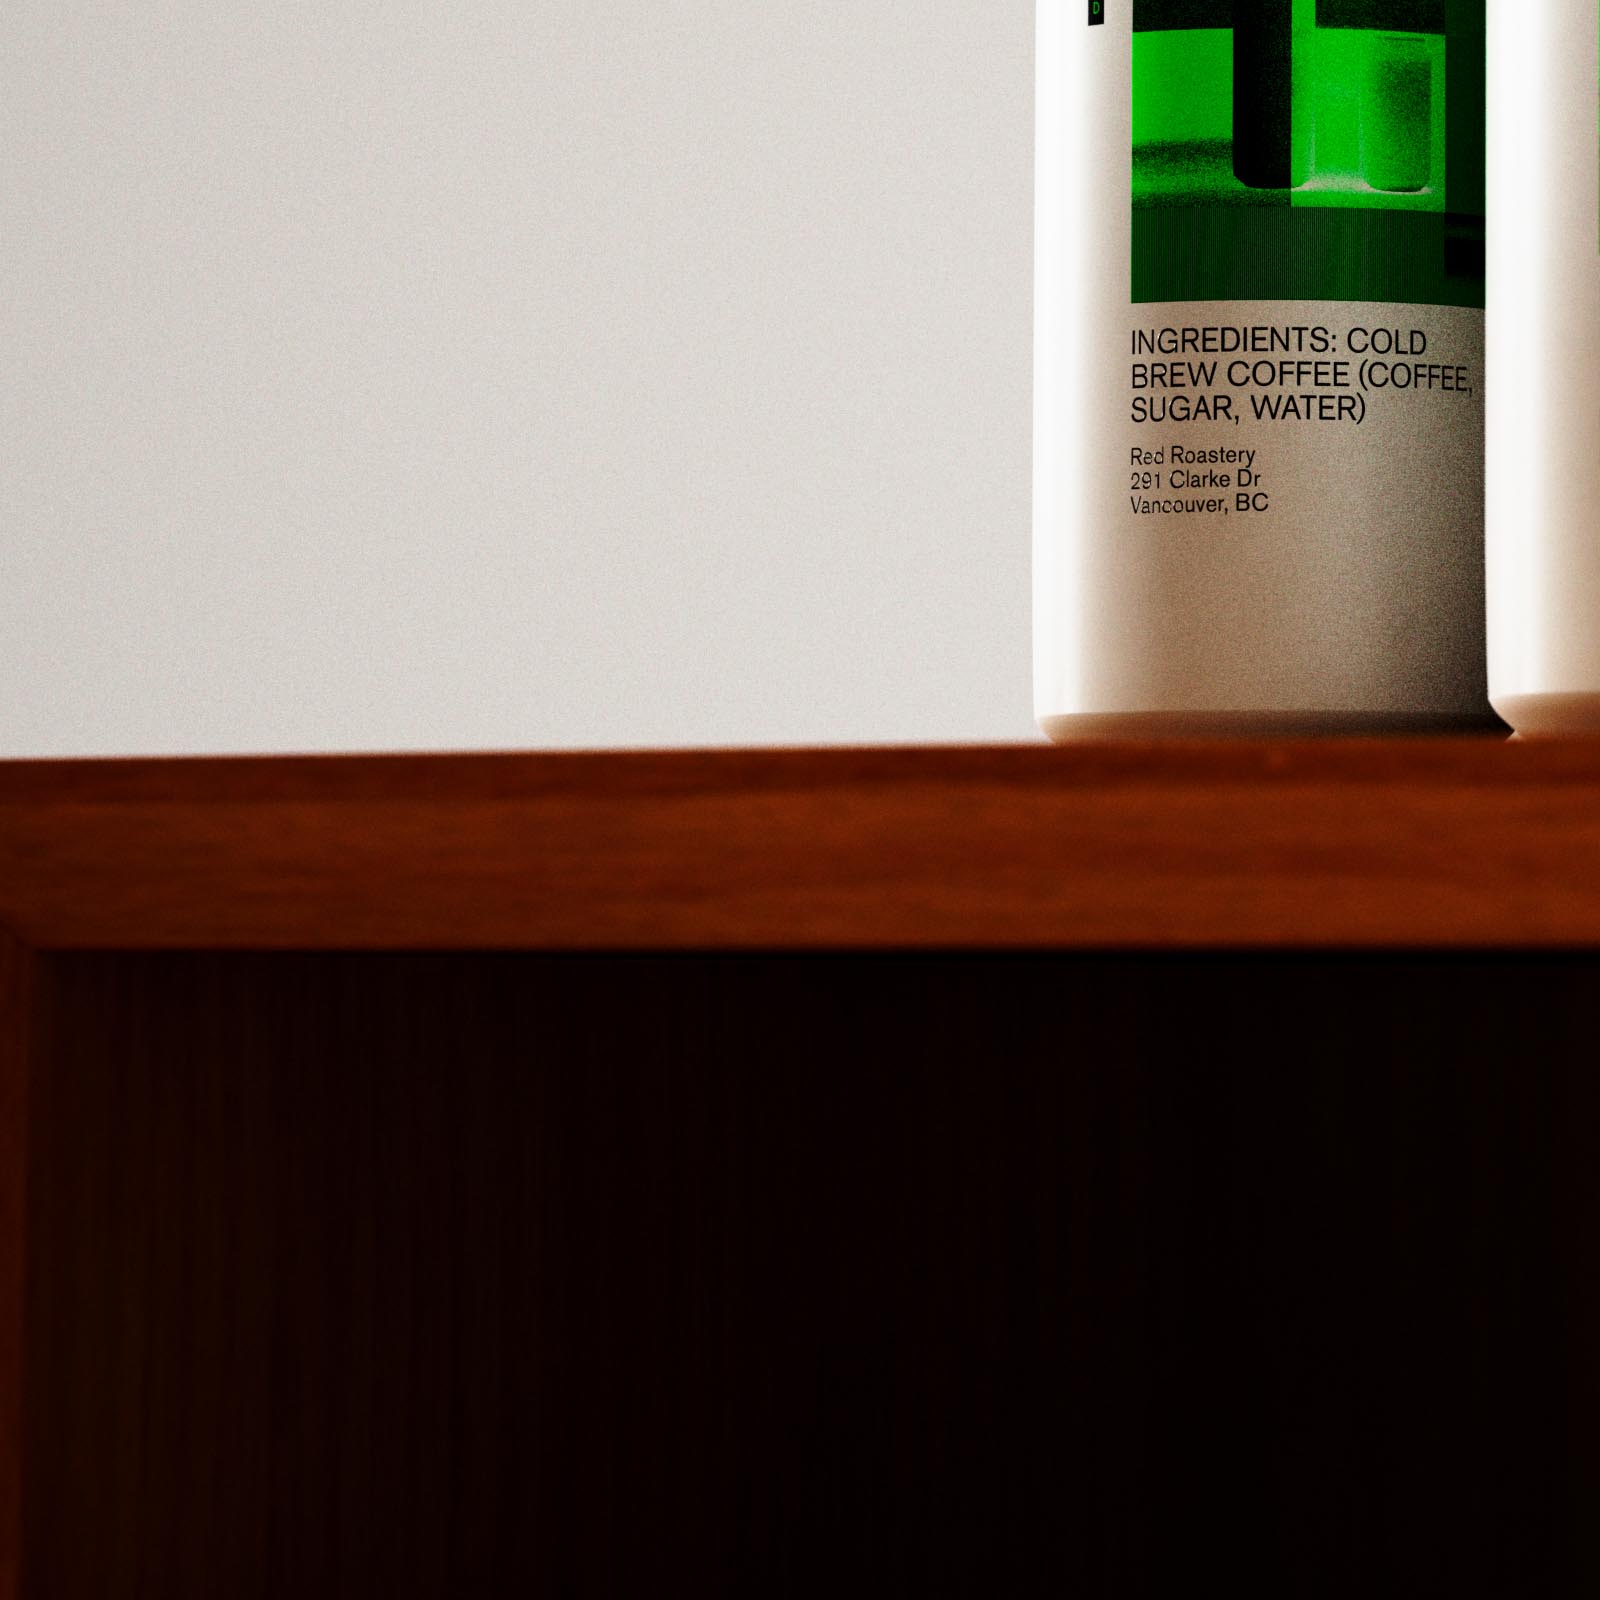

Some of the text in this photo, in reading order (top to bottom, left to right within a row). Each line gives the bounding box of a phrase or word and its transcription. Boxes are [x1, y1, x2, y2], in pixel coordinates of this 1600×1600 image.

[1131, 326, 1428, 356] INGREDIENTS: COLD
[1131, 358, 1474, 398] BREW COFFEE (COFFEE,
[1130, 392, 1367, 425] SUGAR, WATER)
[1130, 445, 1256, 468] Red Roastery
[1130, 468, 1262, 491] 291 Clarke Dr
[1130, 492, 1269, 516] Vancouver, BC
